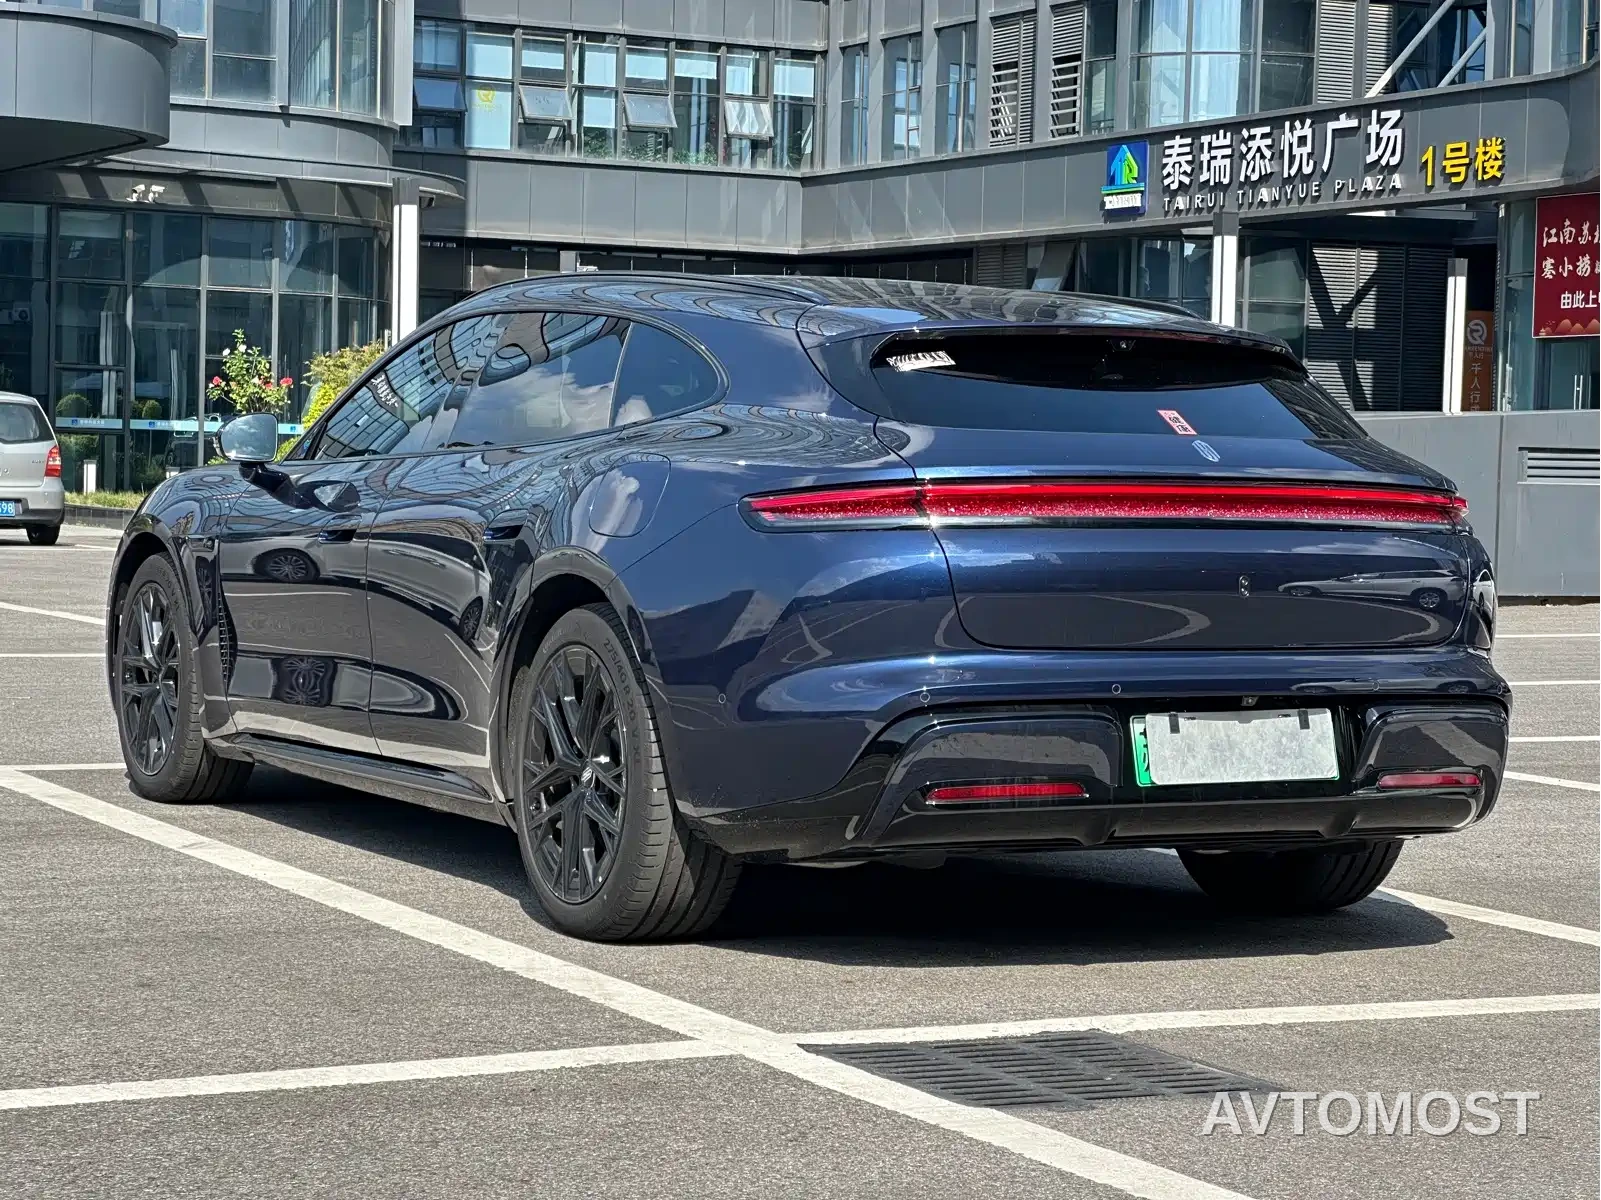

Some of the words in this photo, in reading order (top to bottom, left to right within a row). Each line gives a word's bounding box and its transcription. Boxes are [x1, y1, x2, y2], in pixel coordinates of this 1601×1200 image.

[1162, 110, 1402, 190] 泰瑞添悦广场
[1421, 137, 1503, 186] 1号楼
[1163, 194, 1224, 211] TAIRUI
[1237, 181, 1320, 204] TIANYUE
[1335, 174, 1401, 194] PLAZA
[1560, 290, 1600, 308] 由此上
[0, 502, 14, 514] 98
